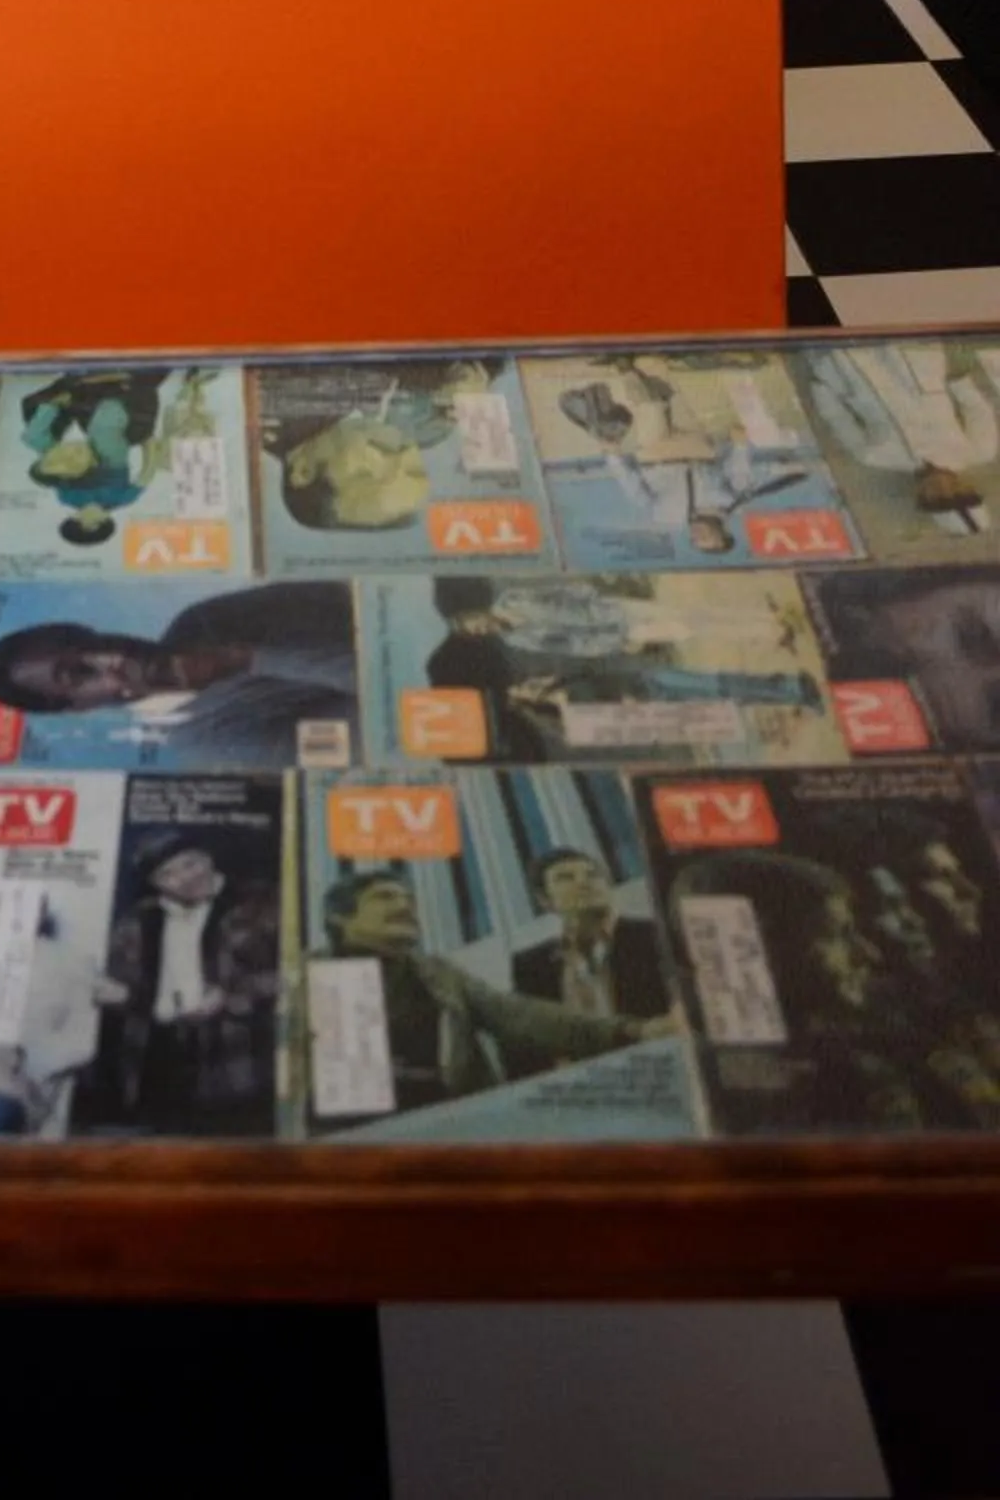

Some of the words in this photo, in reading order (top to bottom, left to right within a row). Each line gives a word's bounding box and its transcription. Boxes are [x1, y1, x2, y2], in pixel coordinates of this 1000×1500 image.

[445, 519, 528, 547] TV
[764, 527, 841, 553] TV
[136, 537, 221, 564] TV
[834, 687, 891, 744] TV
[340, 797, 440, 833] TV
[663, 791, 755, 822] TV
